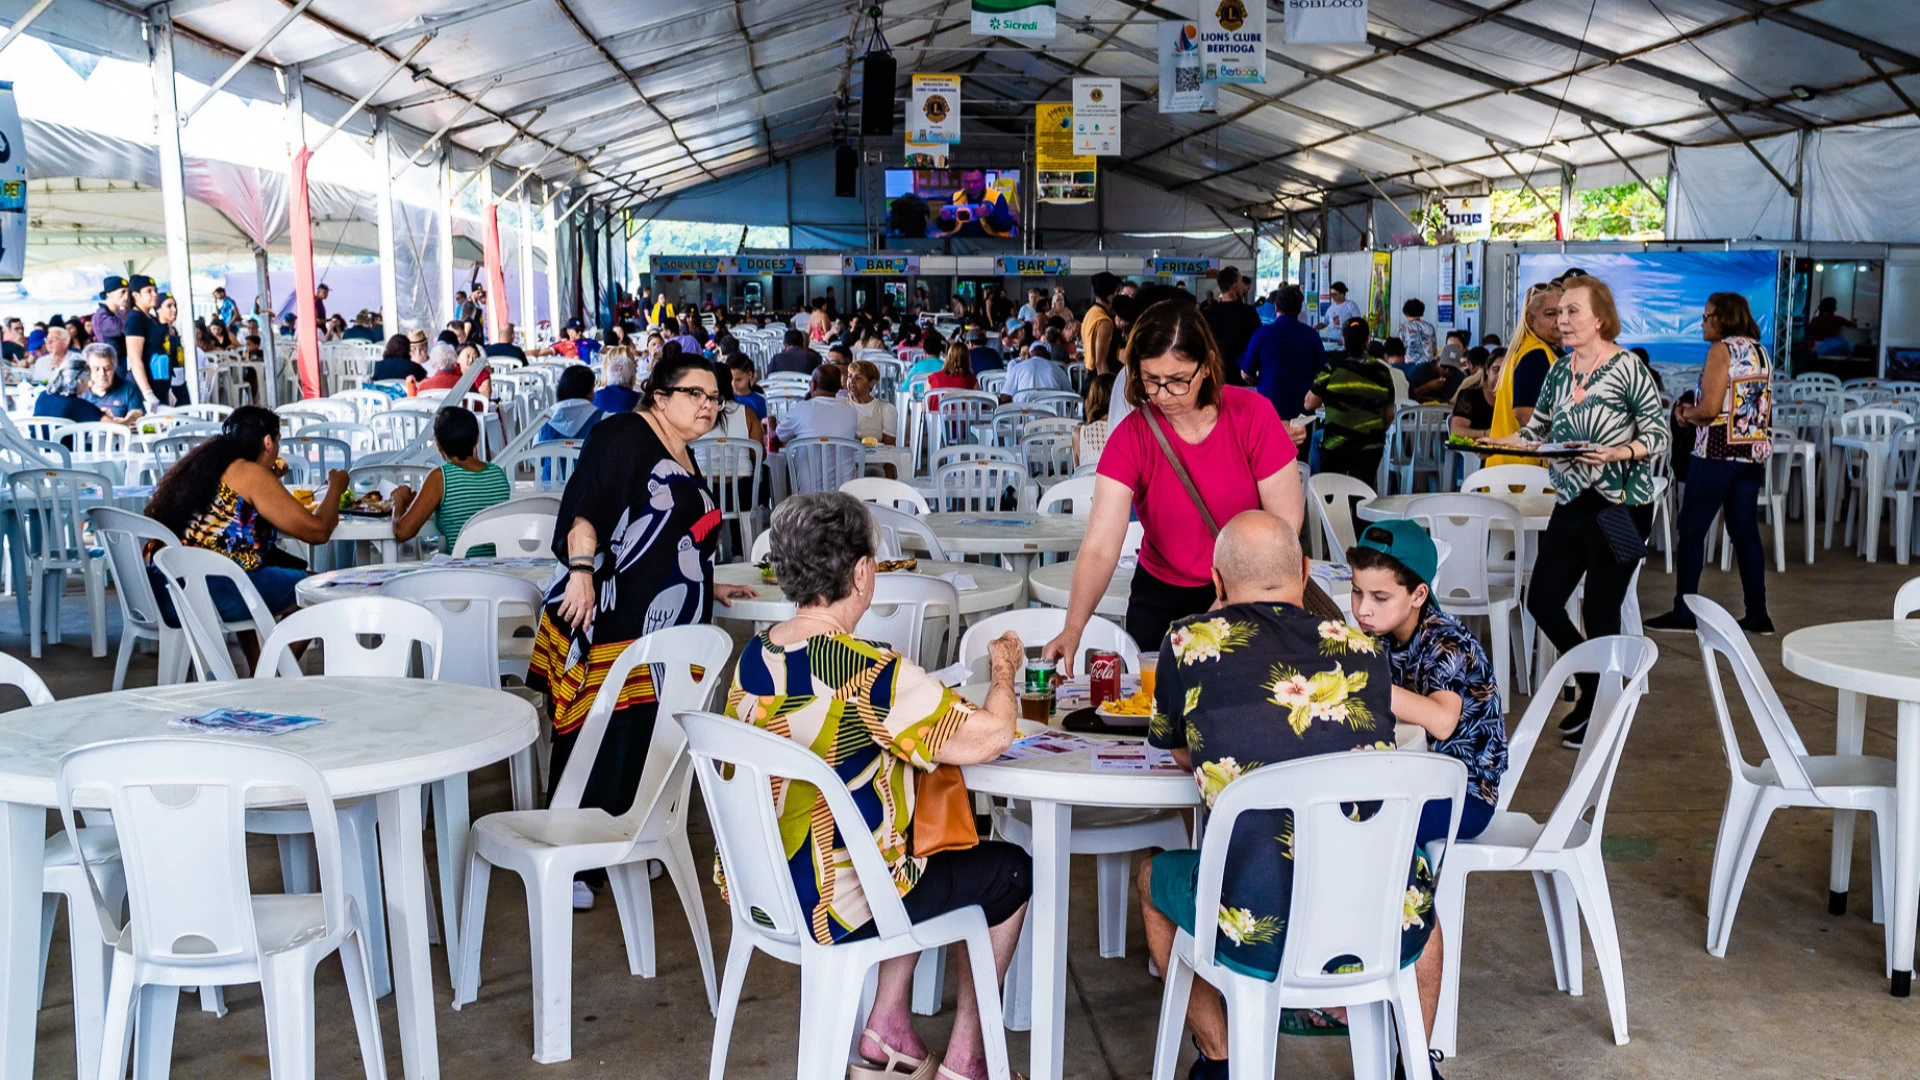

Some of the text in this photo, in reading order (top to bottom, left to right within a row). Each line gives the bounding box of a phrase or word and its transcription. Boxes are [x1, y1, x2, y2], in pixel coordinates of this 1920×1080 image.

[1289, 0, 1363, 9] SOBLOCO
[1003, 19, 1038, 30] Sicredi
[1201, 33, 1262, 42] LIONS CLUBE
[1207, 44, 1255, 53] BERTIOGA
[664, 261, 714, 269] SORVETES
[747, 259, 786, 269] DOCES
[866, 259, 893, 270] BAR
[1017, 259, 1045, 270] BAR
[1162, 262, 1203, 273] FRITAS
[1090, 659, 1114, 680] Cola
